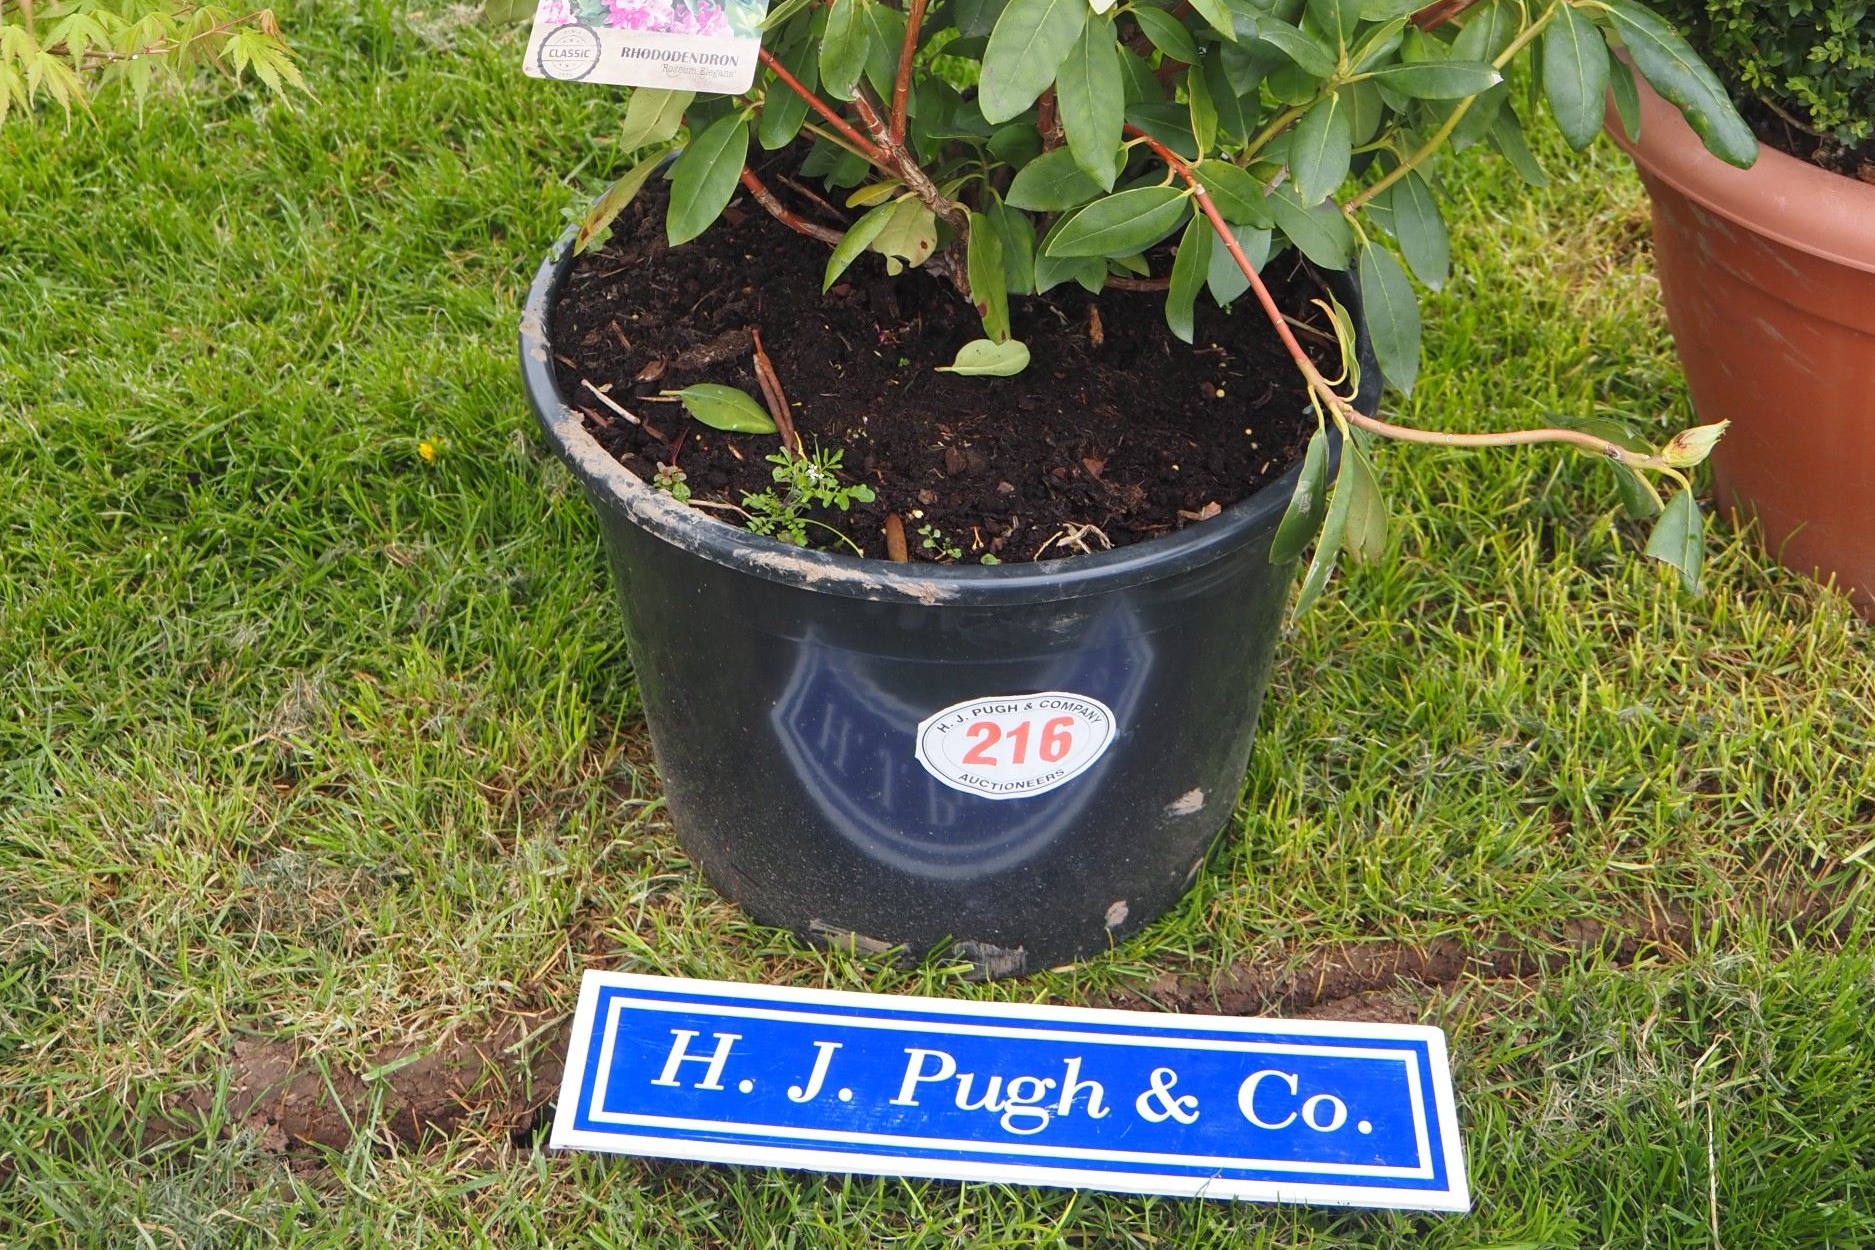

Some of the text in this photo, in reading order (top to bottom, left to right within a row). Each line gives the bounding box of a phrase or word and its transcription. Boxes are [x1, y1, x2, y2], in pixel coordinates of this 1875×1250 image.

[621, 46, 739, 67] RHODODENDRON
[937, 700, 1103, 734] H. J. PUGH & COMPANY
[962, 716, 1075, 767] 216
[958, 768, 1065, 791] AUCTIONEERS
[650, 1029, 1373, 1135] H. J. Pugh & Co.
